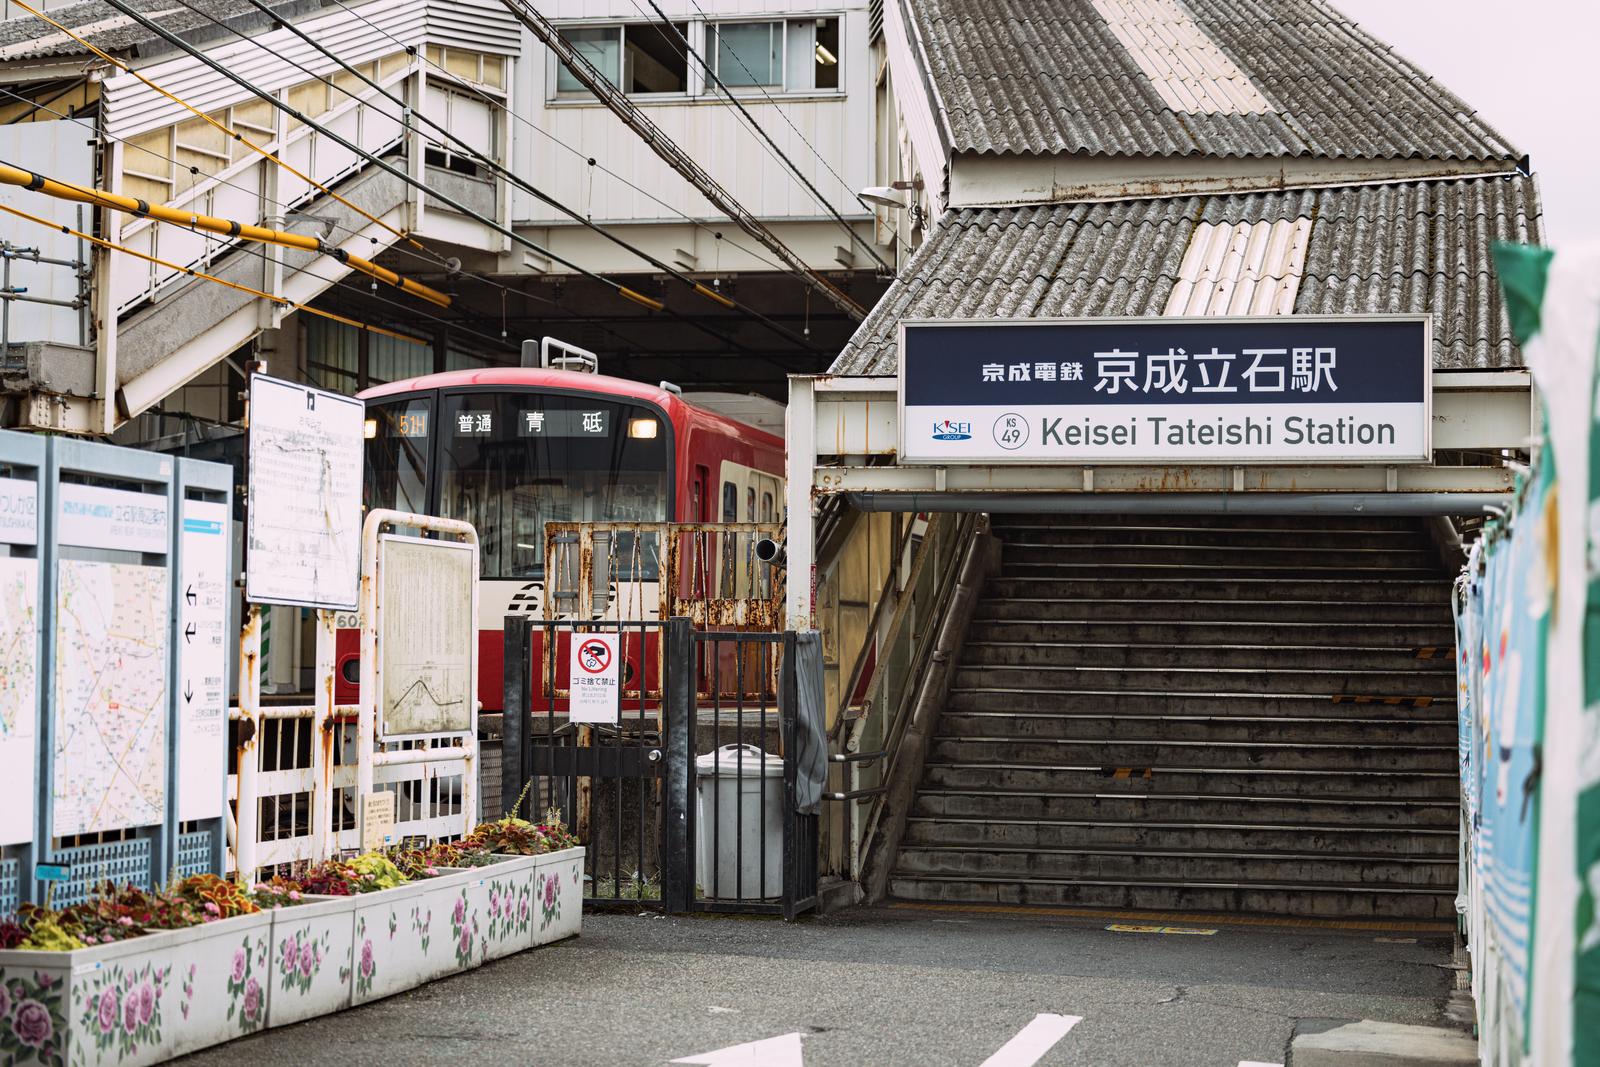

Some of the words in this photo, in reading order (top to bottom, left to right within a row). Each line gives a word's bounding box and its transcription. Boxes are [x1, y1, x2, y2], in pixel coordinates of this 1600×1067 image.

[982, 362, 1084, 382] 京成電鉄
[1093, 347, 1338, 394] 京成立石駅
[458, 414, 492, 433] 普通
[1006, 418, 1017, 428] KS
[1042, 417, 1137, 446] Keisei
[1147, 416, 1272, 446] Tateishi
[1283, 416, 1395, 446] Station
[1001, 429, 1021, 444] 49
[573, 677, 615, 686] ゴミ捨て禁止
